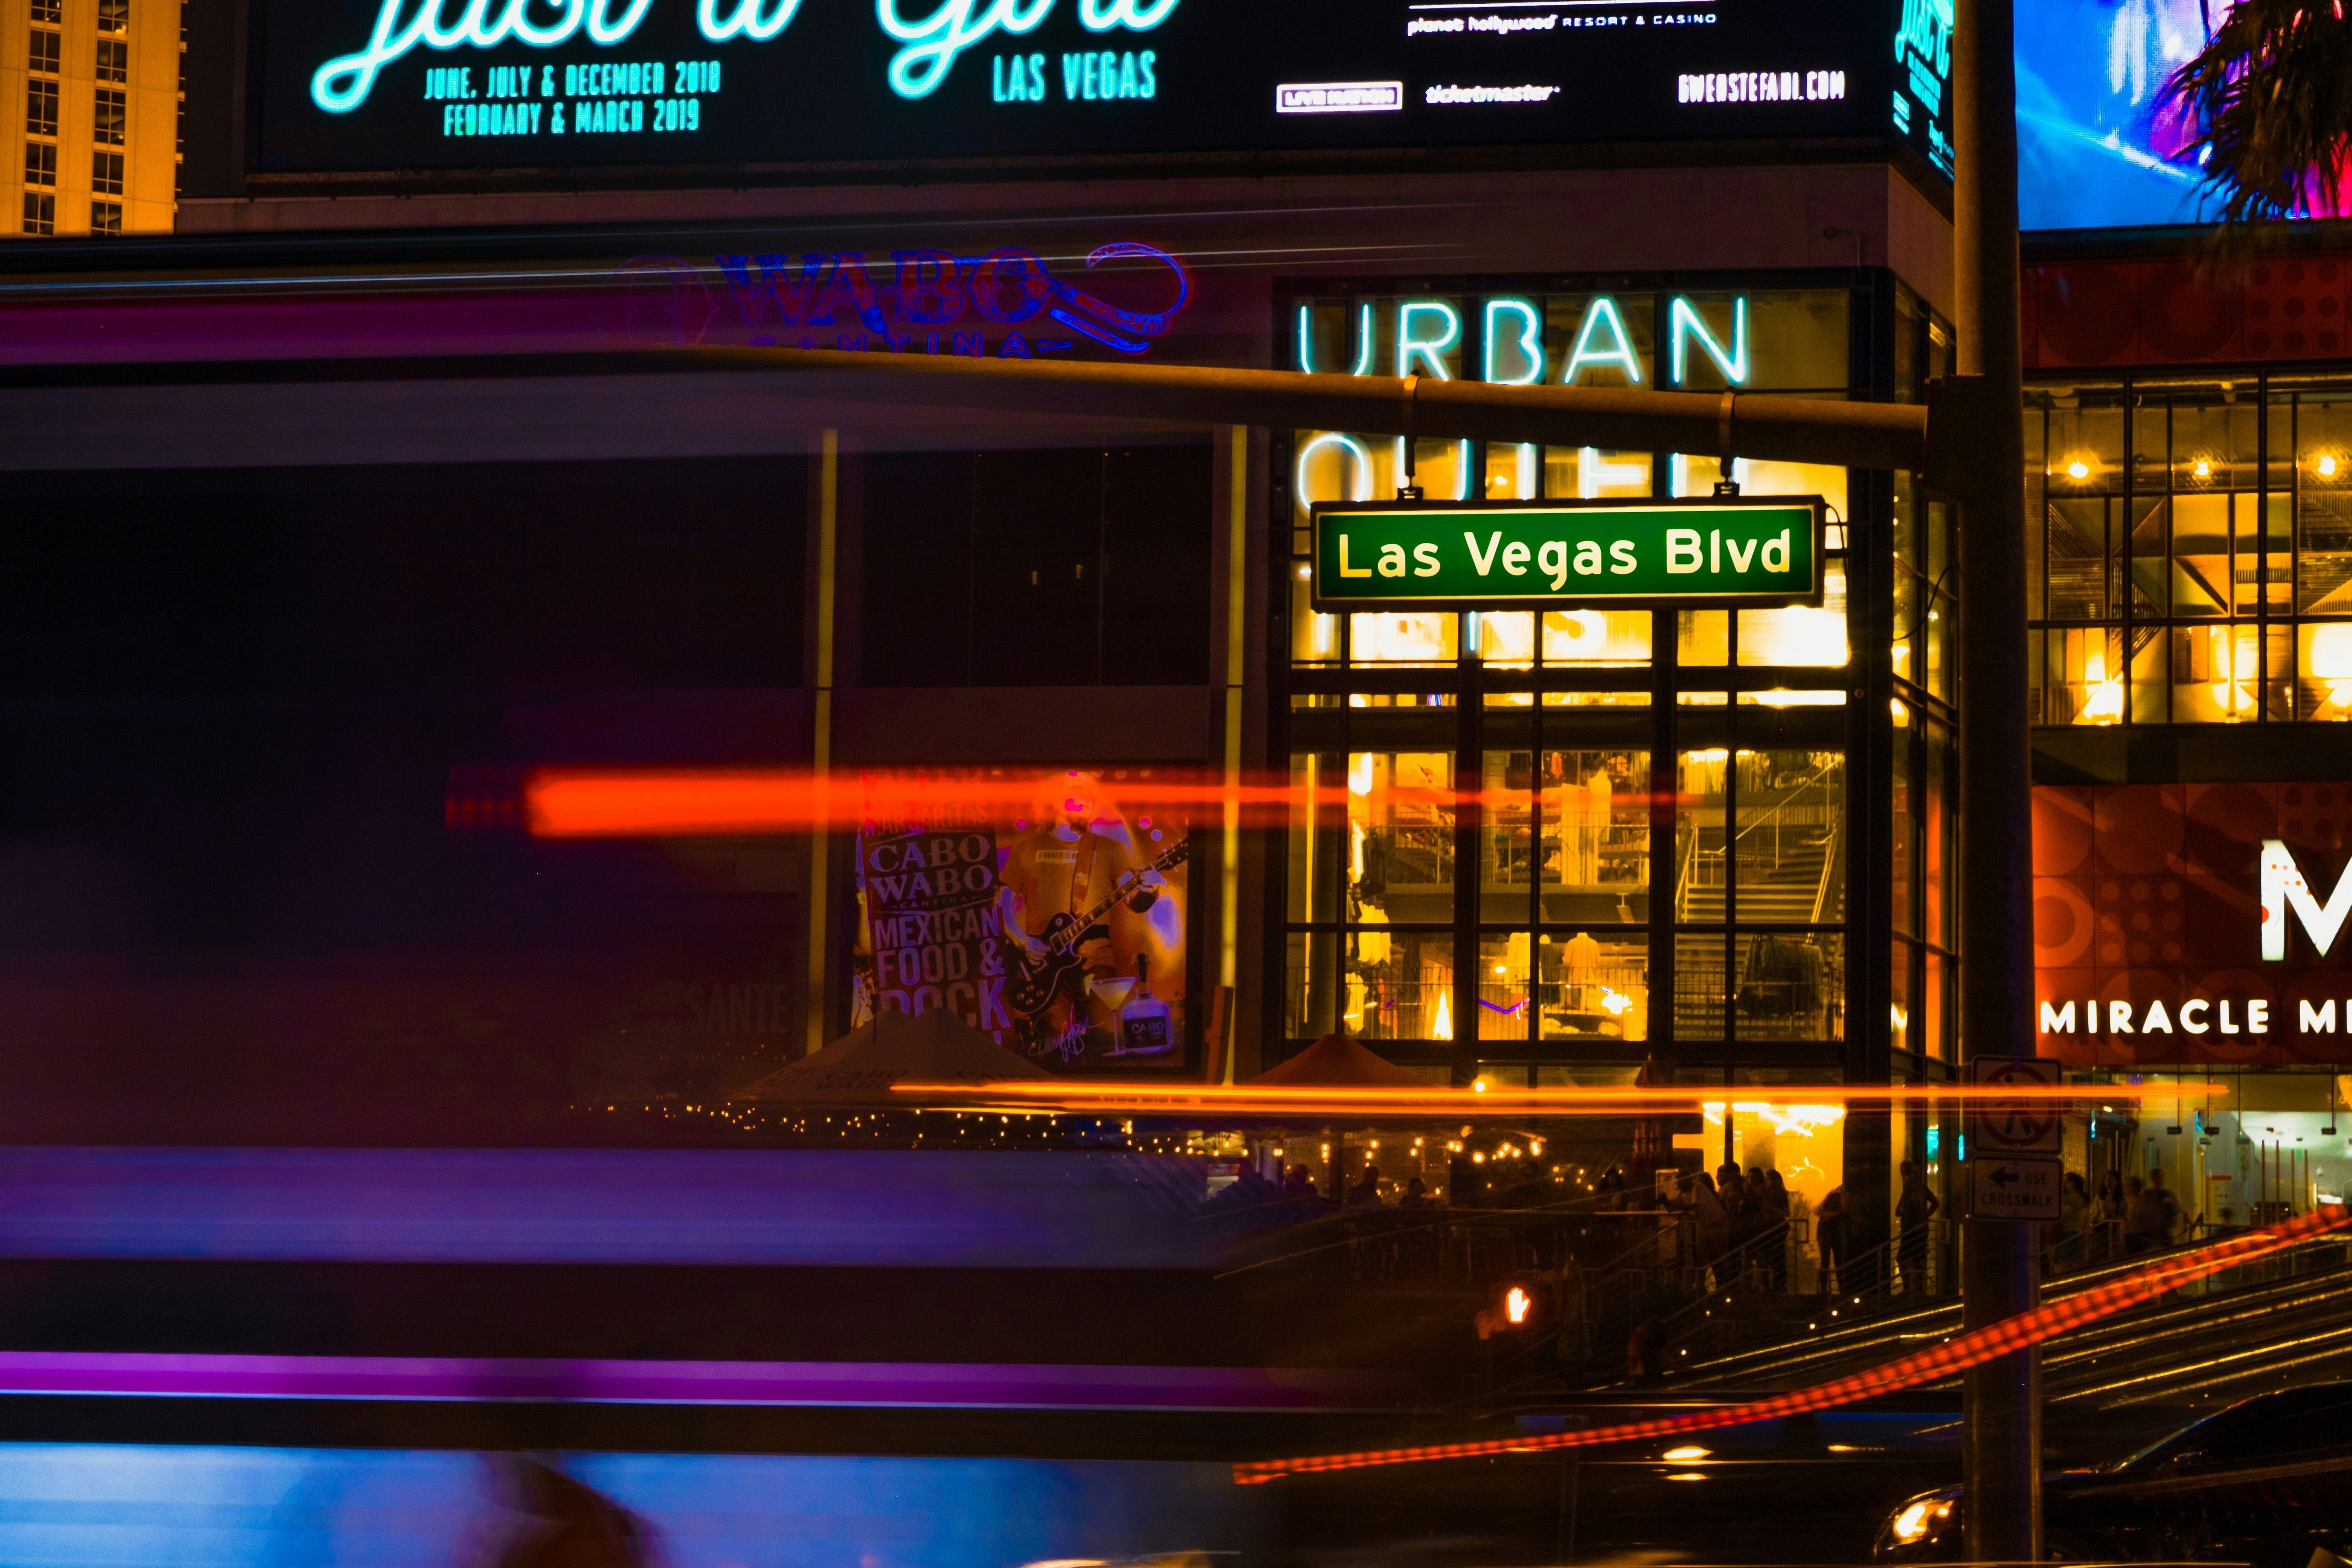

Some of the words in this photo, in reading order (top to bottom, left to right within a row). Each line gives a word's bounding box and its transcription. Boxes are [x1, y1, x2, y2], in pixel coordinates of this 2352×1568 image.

[1408, 18, 1464, 36] planet
[1468, 15, 1558, 34] hollywood
[1562, 16, 1628, 27] RESORT
[1635, 16, 1645, 25] &
[1653, 14, 1717, 25] CASINO
[424, 68, 477, 99] JUNE,
[486, 66, 532, 98] JULY
[541, 65, 555, 96] &
[566, 62, 664, 96] DECEMBER
[675, 61, 721, 93] 2018
[993, 54, 1045, 102] LAS
[1062, 51, 1156, 101] VEGAS
[1425, 84, 1554, 104] ticketmaster
[444, 103, 542, 136] FEBRUARY
[551, 102, 564, 134] &
[575, 100, 643, 133] MARCH
[653, 98, 699, 132] 2019
[714, 247, 1049, 334] WABO
[1297, 295, 1747, 385] URBAN
[1339, 534, 1441, 578] Las
[1463, 531, 1637, 591] Vegas
[1666, 528, 1790, 574] Blvd
[869, 834, 991, 872] CABO
[870, 865, 993, 903] WABO
[900, 896, 967, 909] CANTINA
[2261, 839, 2352, 961] M
[874, 906, 1001, 949] MEXICAN
[877, 942, 968, 988] FOOD
[980, 937, 1006, 976] &
[1130, 1021, 1165, 1035] CABO
[2040, 998, 2268, 1034] MIRACLE
[2026, 1172, 2048, 1185] USE
[1981, 1192, 2052, 1207] CROSSWALK
